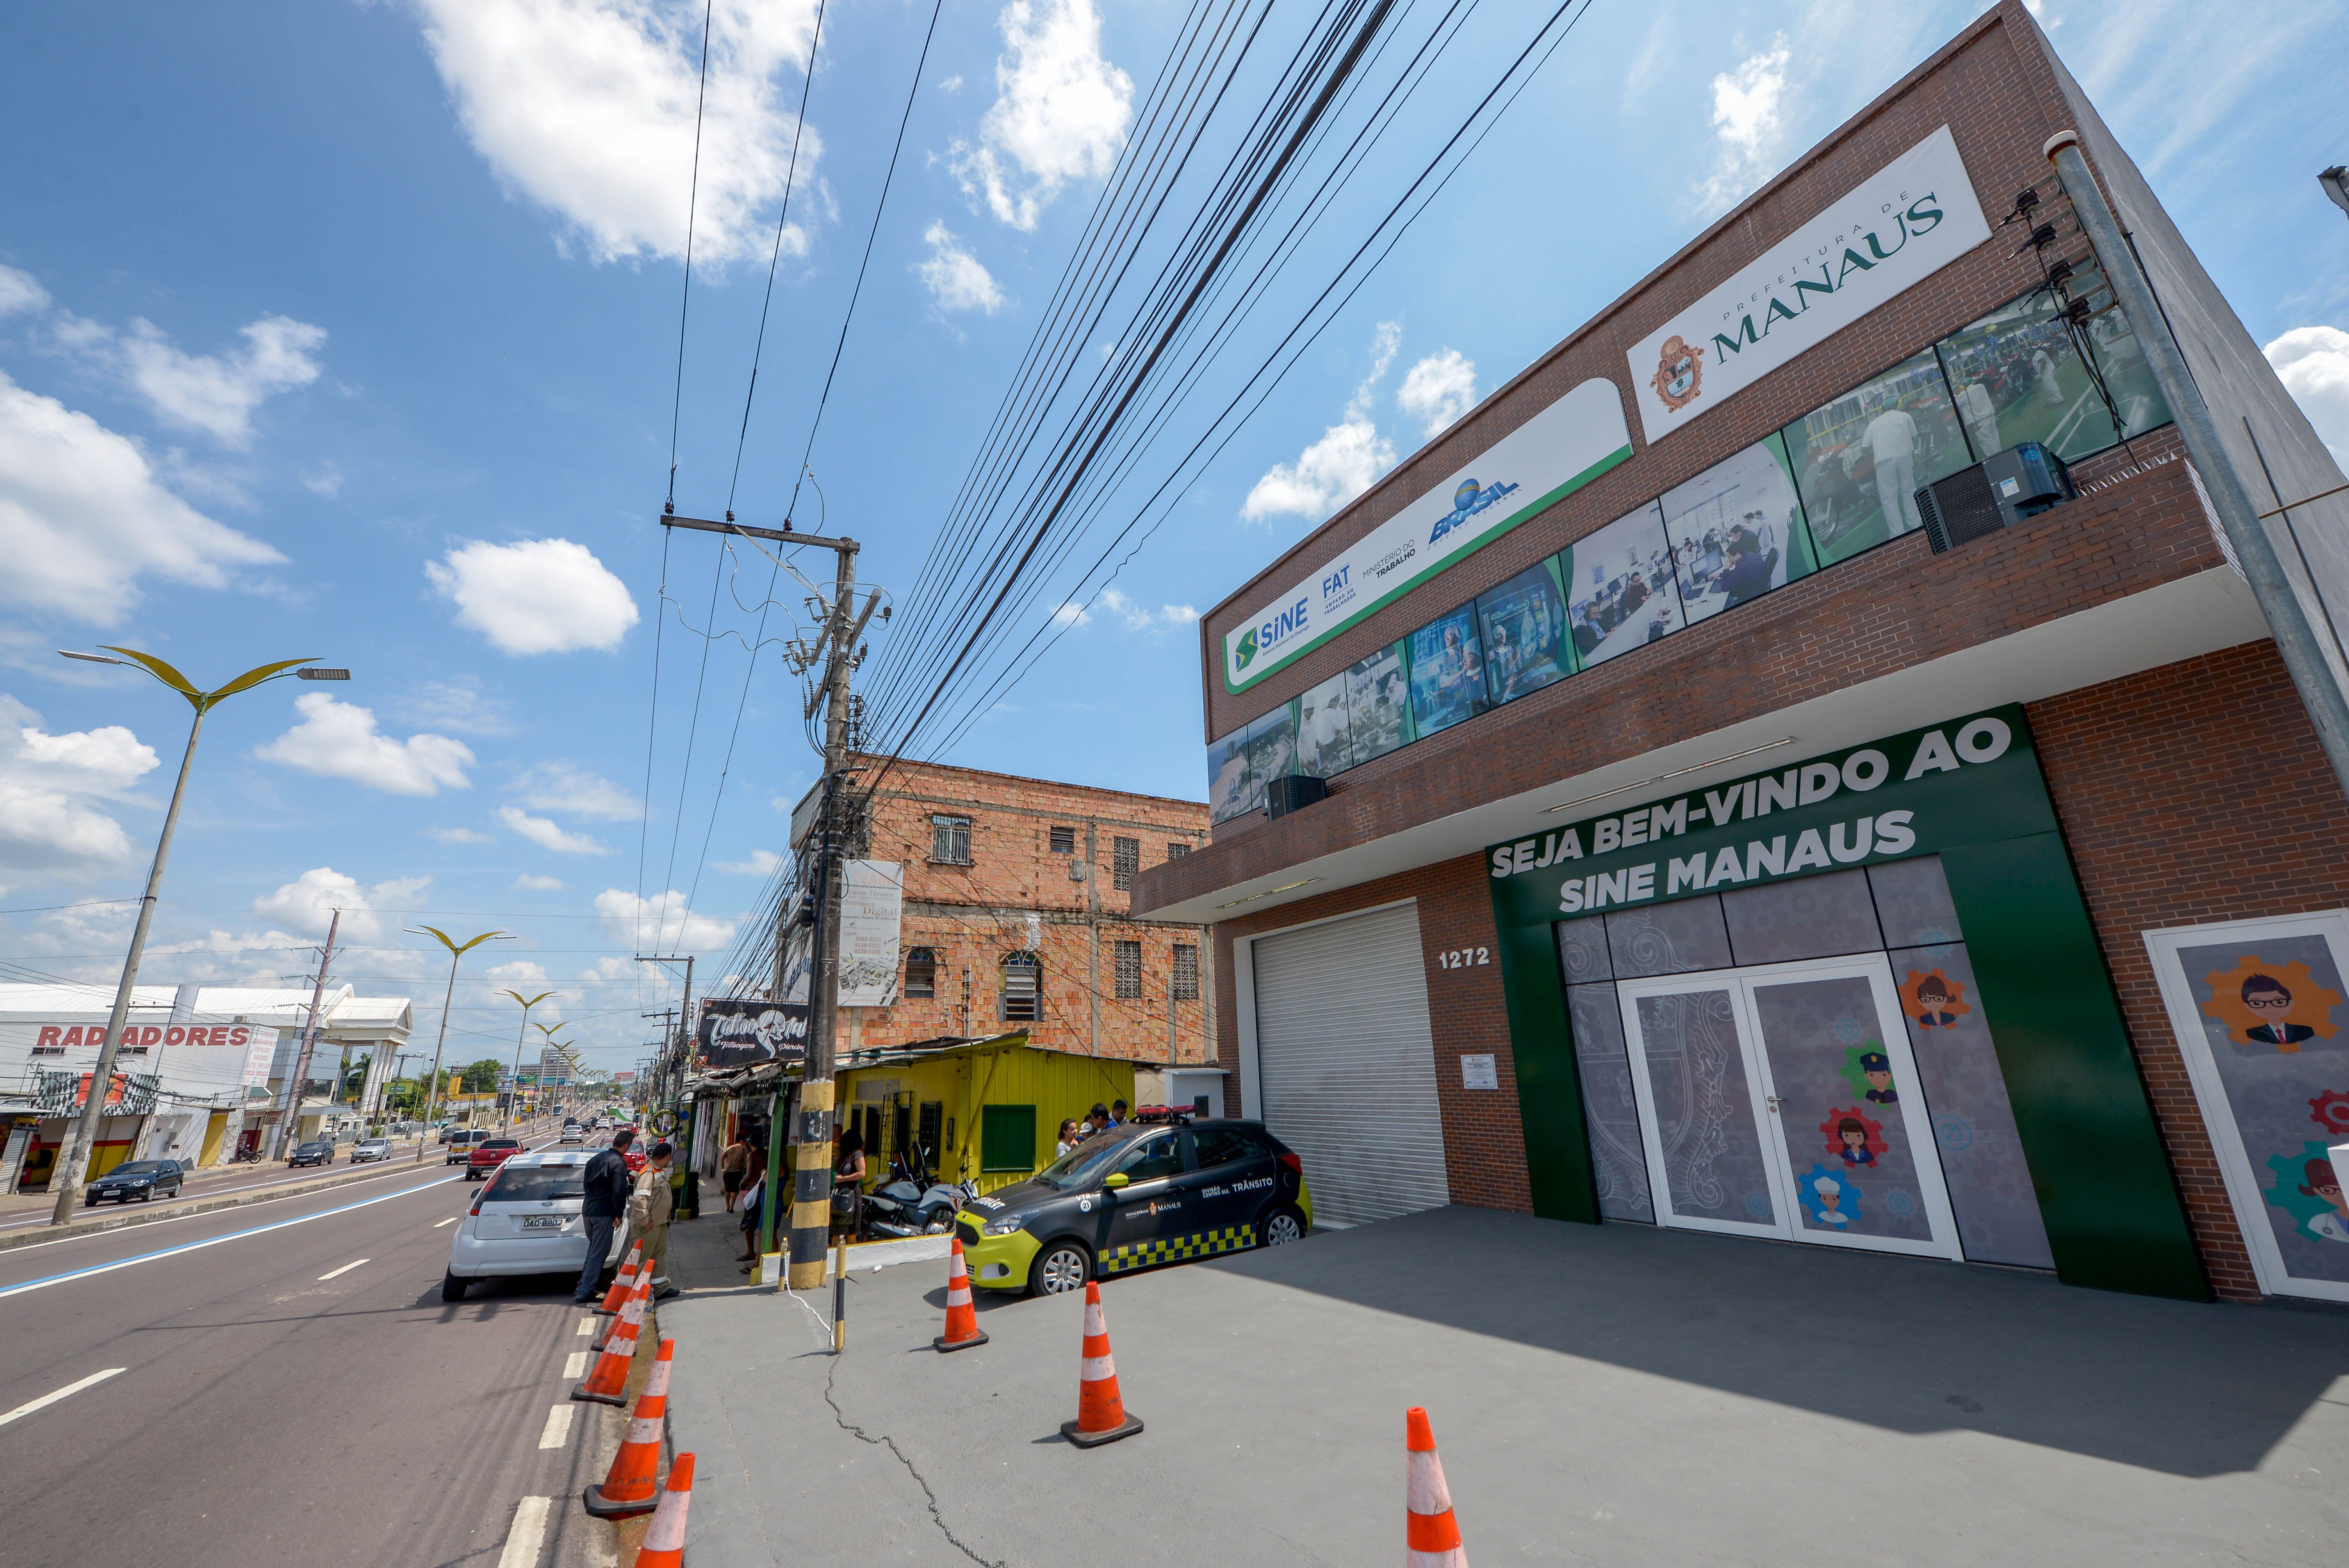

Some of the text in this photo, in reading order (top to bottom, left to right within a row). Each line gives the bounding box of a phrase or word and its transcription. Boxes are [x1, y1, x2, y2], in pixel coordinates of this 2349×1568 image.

[1723, 191, 1909, 321] PREFEITURA DE
[1710, 191, 1944, 365] MANAUS
[1427, 522, 1469, 551] GOVERNO
[1477, 488, 1522, 519] FEDERAL
[1428, 481, 1520, 545] BRASIL
[1363, 540, 1414, 578] MINISTÉRIO DO
[1376, 549, 1415, 578] TRABALHO
[1323, 564, 1350, 599] FAT
[1324, 592, 1356, 615] TRABALHADOR
[1325, 593, 1345, 609] AMPARO
[1262, 647, 1275, 657] Sistema
[1276, 636, 1290, 648] Nacional
[1295, 625, 1310, 637] Emprego
[1491, 717, 2011, 878] SEJA BEM-VINDO AO
[1559, 810, 1916, 913] SINE MANAUS
[863, 907, 897, 917] Digital
[1439, 947, 1490, 969] 1272
[37, 1026, 250, 1046] RADADORES
[706, 1013, 757, 1046] Tattoo
[721, 1041, 756, 1050] Tatuagens
[1076, 1193, 1091, 1201] VTR
[1232, 1177, 1273, 1193] TRÂNSITO
[1158, 1201, 1182, 1212] MANAUS
